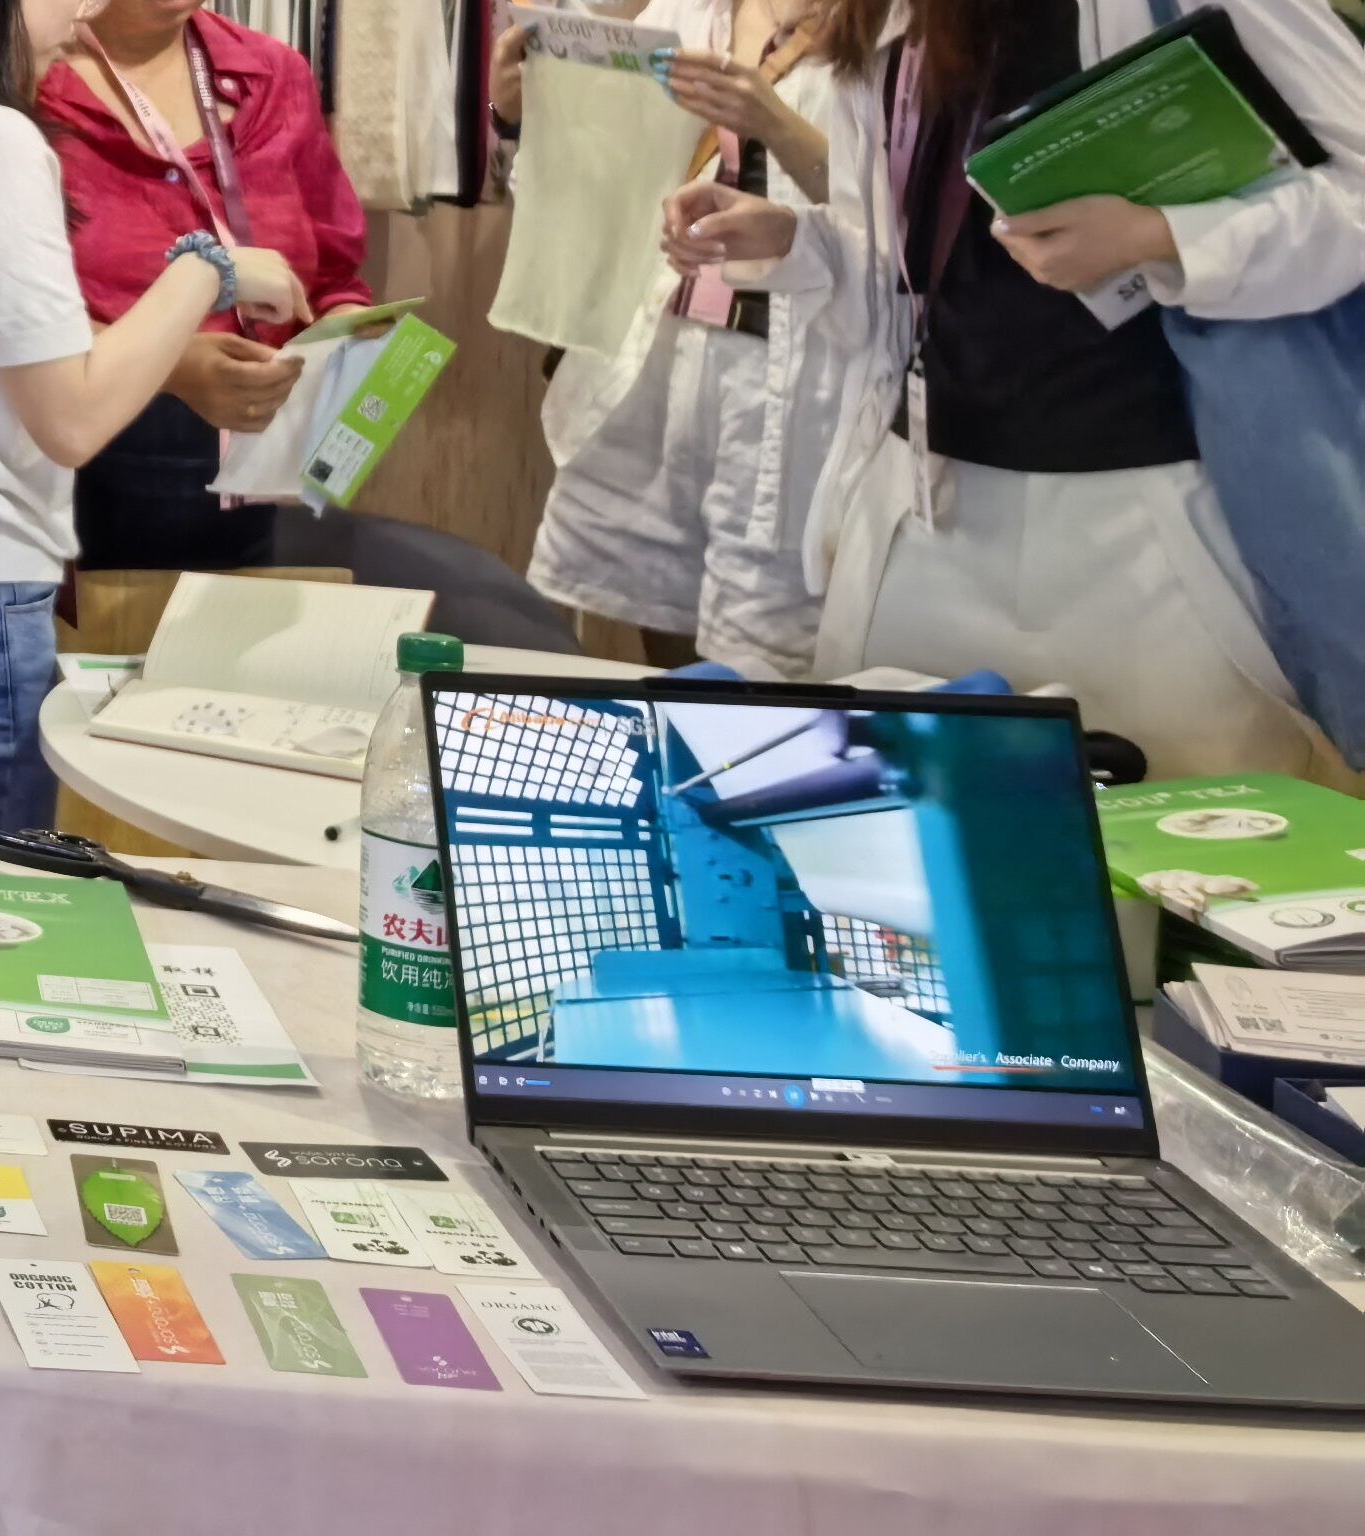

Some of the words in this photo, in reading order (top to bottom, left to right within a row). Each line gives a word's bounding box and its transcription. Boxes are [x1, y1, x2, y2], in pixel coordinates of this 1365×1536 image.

[995, 1051, 1054, 1067] Associate
[1060, 1054, 1121, 1073] Company
[68, 1122, 214, 1145] SUPIMA
[294, 1154, 404, 1168] sorona
[9, 1271, 73, 1284] ORGANIC
[13, 1280, 78, 1293] COTTON
